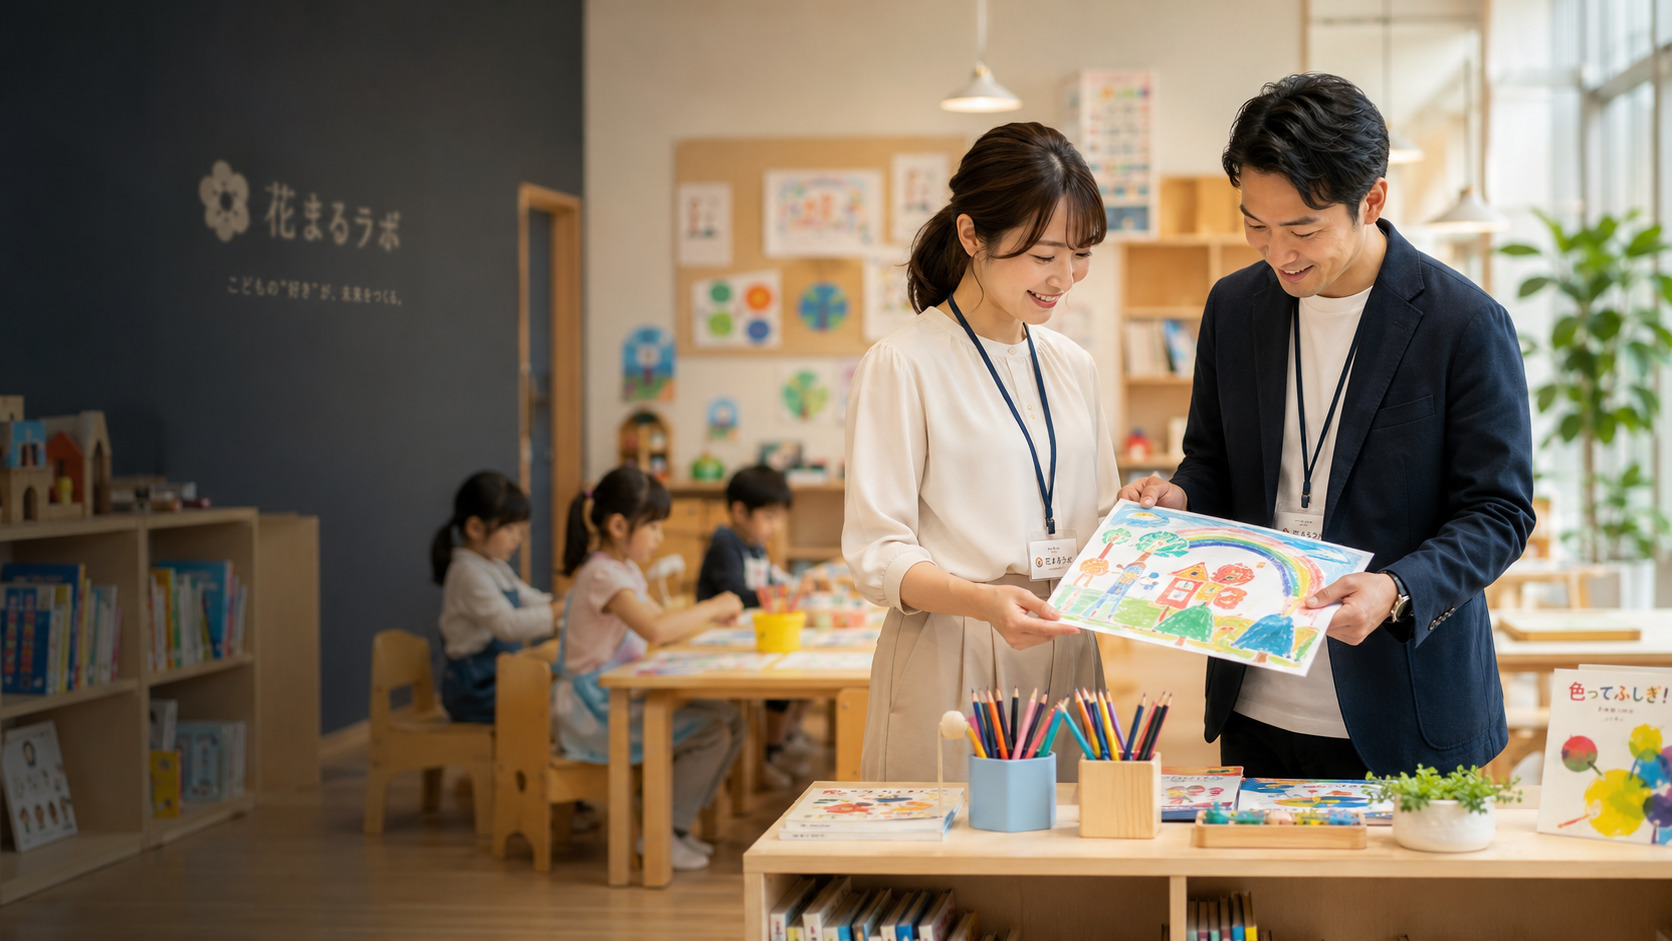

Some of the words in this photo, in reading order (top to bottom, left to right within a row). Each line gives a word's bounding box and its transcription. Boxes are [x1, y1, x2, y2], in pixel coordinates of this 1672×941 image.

[264, 181, 401, 252] 花まるラボ
[1569, 681, 1669, 704] 色ってふしぎ!
